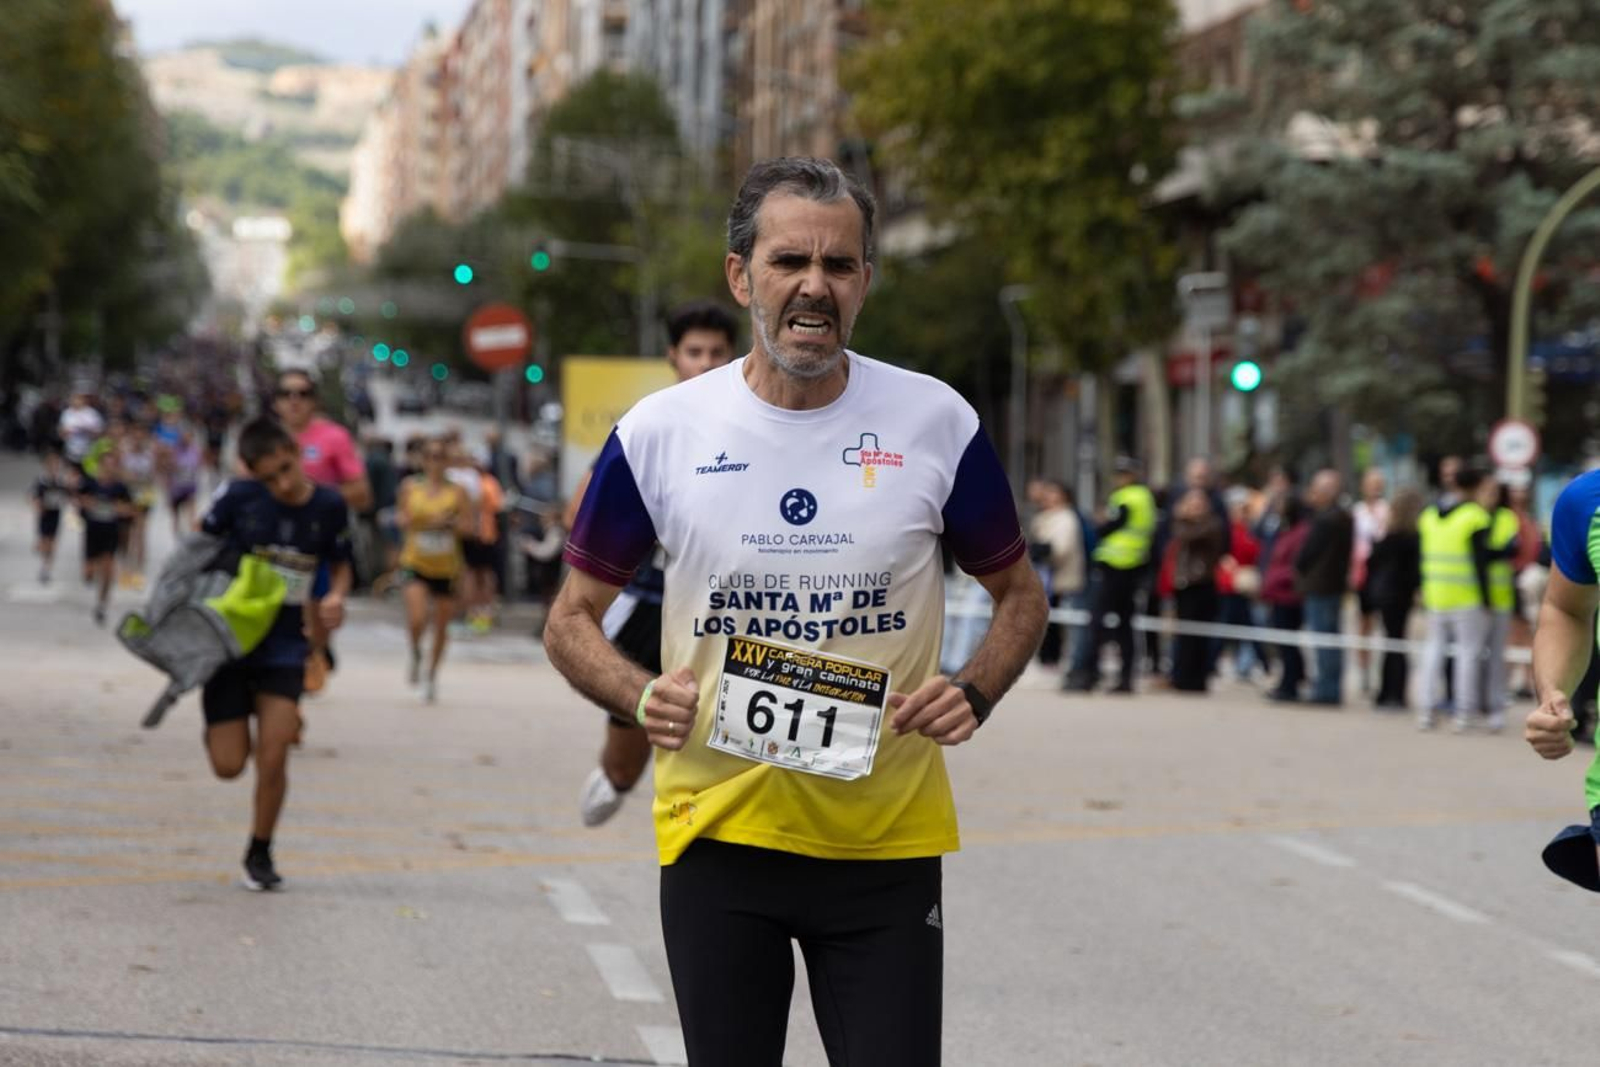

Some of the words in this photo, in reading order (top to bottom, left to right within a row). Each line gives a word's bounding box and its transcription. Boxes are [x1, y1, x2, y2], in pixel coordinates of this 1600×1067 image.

[695, 462, 750, 475] TEAMERGY
[741, 533, 785, 546] PABLO
[788, 532, 855, 546] CARVAJAL
[708, 574, 755, 589] CLUB
[764, 574, 790, 589] DE
[799, 571, 892, 590] RUNNING
[709, 591, 800, 613] SANTA
[852, 588, 887, 610] DE
[694, 616, 737, 637] LOS
[746, 611, 906, 642] APÓSTOLES
[731, 641, 768, 666] XXV
[768, 649, 823, 669] CARRERA
[825, 661, 882, 682] POPULAR
[767, 658, 775, 670] y
[781, 662, 813, 677] gran
[819, 671, 881, 692] caminata
[747, 690, 838, 748] 611
